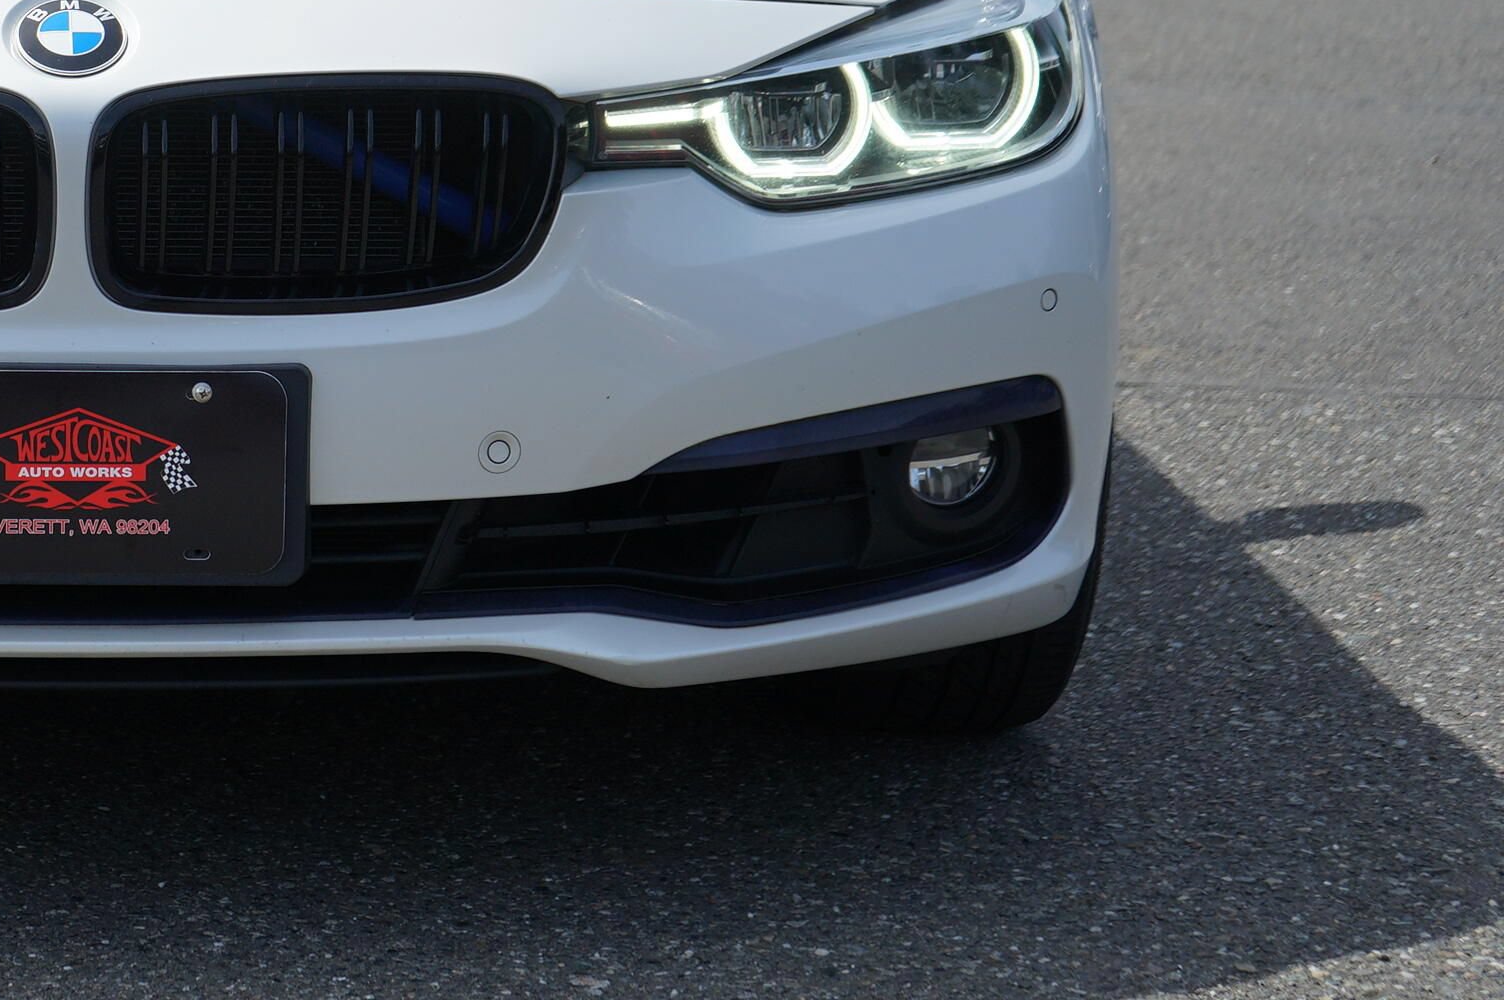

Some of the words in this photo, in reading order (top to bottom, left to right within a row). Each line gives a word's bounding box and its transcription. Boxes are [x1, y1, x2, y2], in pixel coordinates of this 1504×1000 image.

[27, 0, 116, 22] BMW
[18, 466, 65, 478] AUTO
[71, 466, 133, 478] WORKS
[79, 518, 112, 535] WA
[116, 518, 171, 535] 98204
